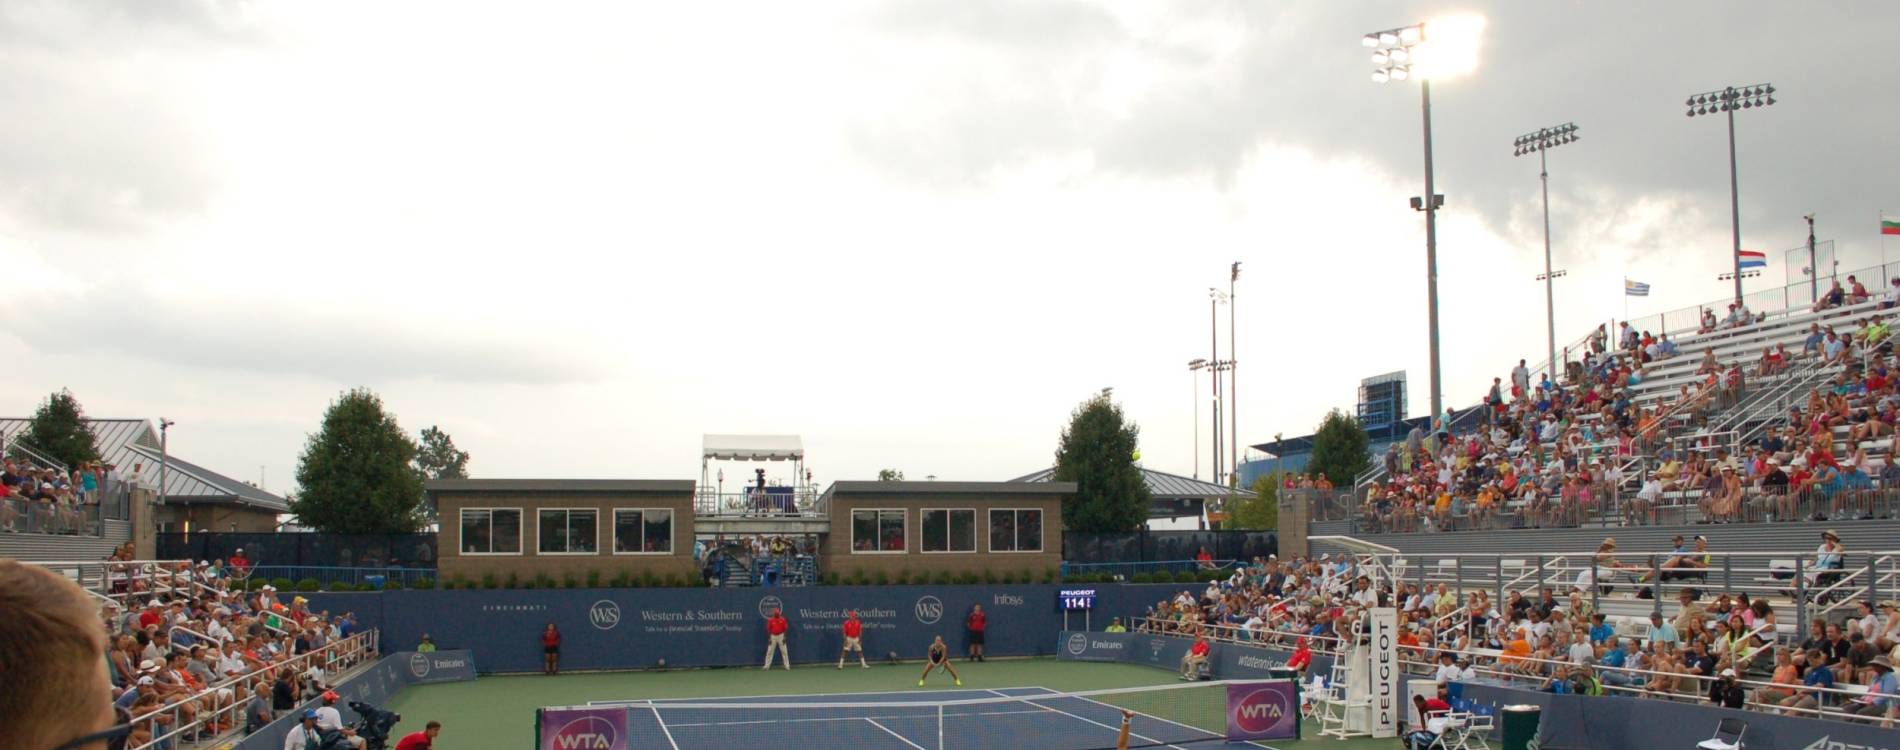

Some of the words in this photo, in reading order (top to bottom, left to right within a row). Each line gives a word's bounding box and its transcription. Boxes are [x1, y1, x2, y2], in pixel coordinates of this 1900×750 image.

[994, 593, 1024, 606] Infosys
[1065, 598, 1085, 608] 114
[641, 610, 683, 621] Western
[685, 610, 695, 621] &
[697, 610, 743, 621] Southern
[800, 608, 840, 618] Western
[853, 608, 896, 618] Southern
[1092, 640, 1123, 650] Emirates
[1238, 655, 1285, 670] wtatennis.co
[1379, 620, 1390, 725] PEUGEOT
[1240, 704, 1282, 719] WTA
[558, 732, 610, 749] WTA
